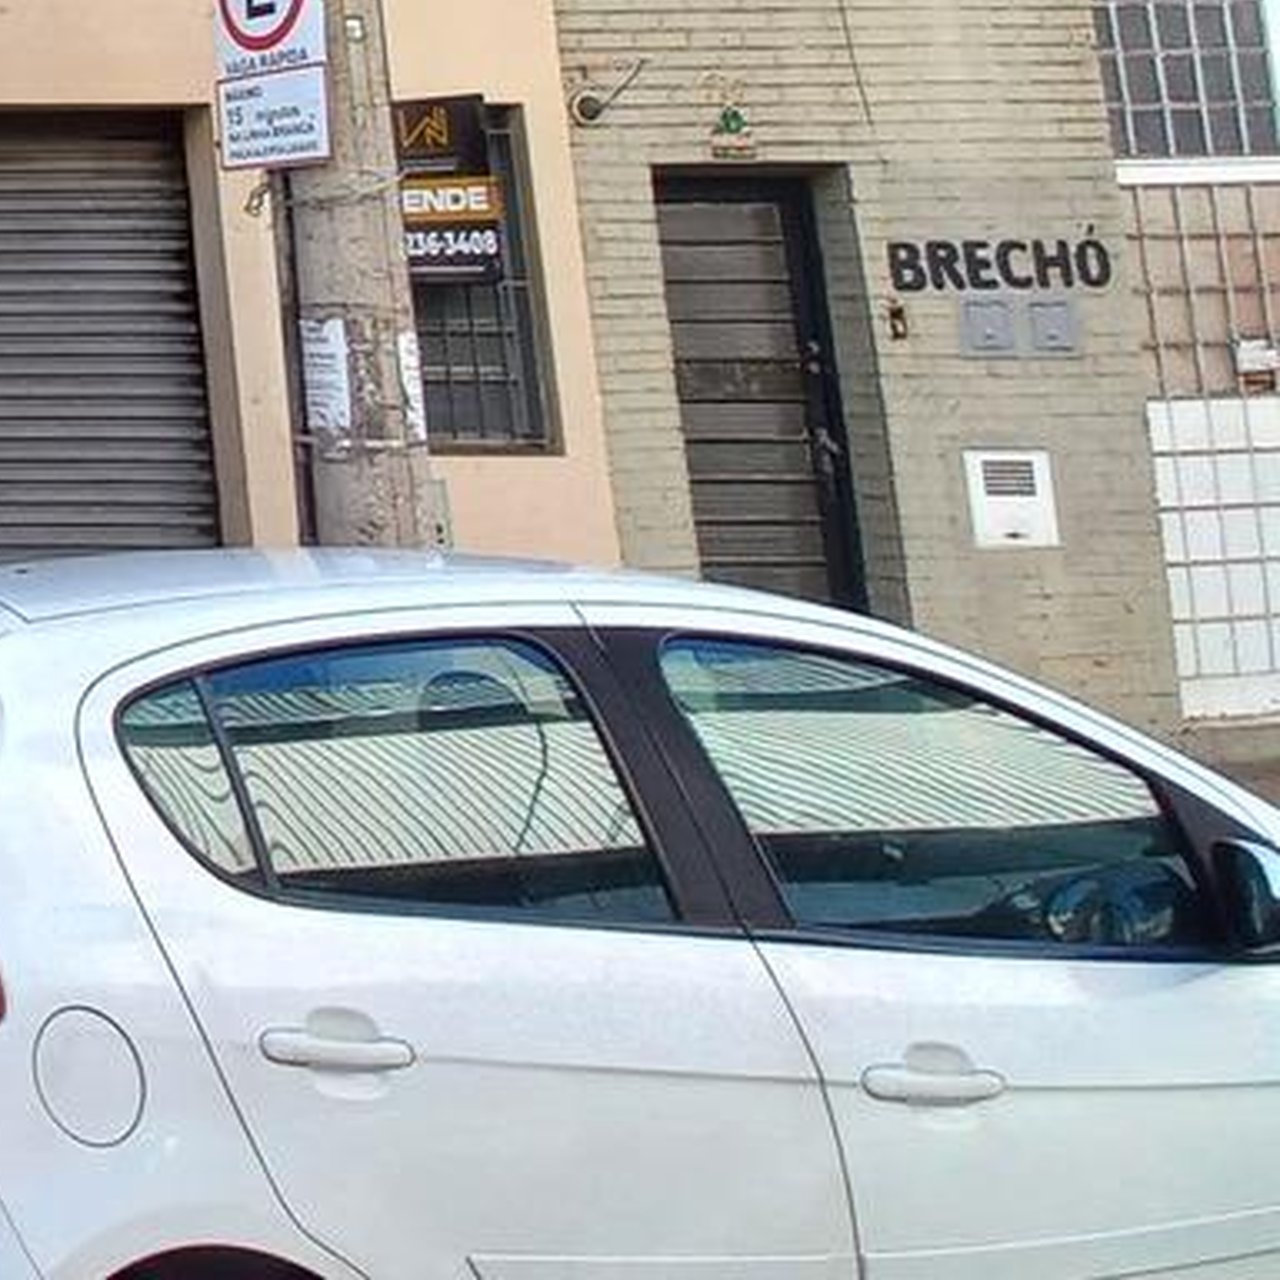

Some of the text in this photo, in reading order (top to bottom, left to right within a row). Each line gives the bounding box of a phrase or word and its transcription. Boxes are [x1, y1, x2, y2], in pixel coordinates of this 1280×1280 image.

[403, 186, 490, 215] ENDE
[405, 230, 498, 256] 236-3408
[887, 223, 1111, 292] BRECHÓ
